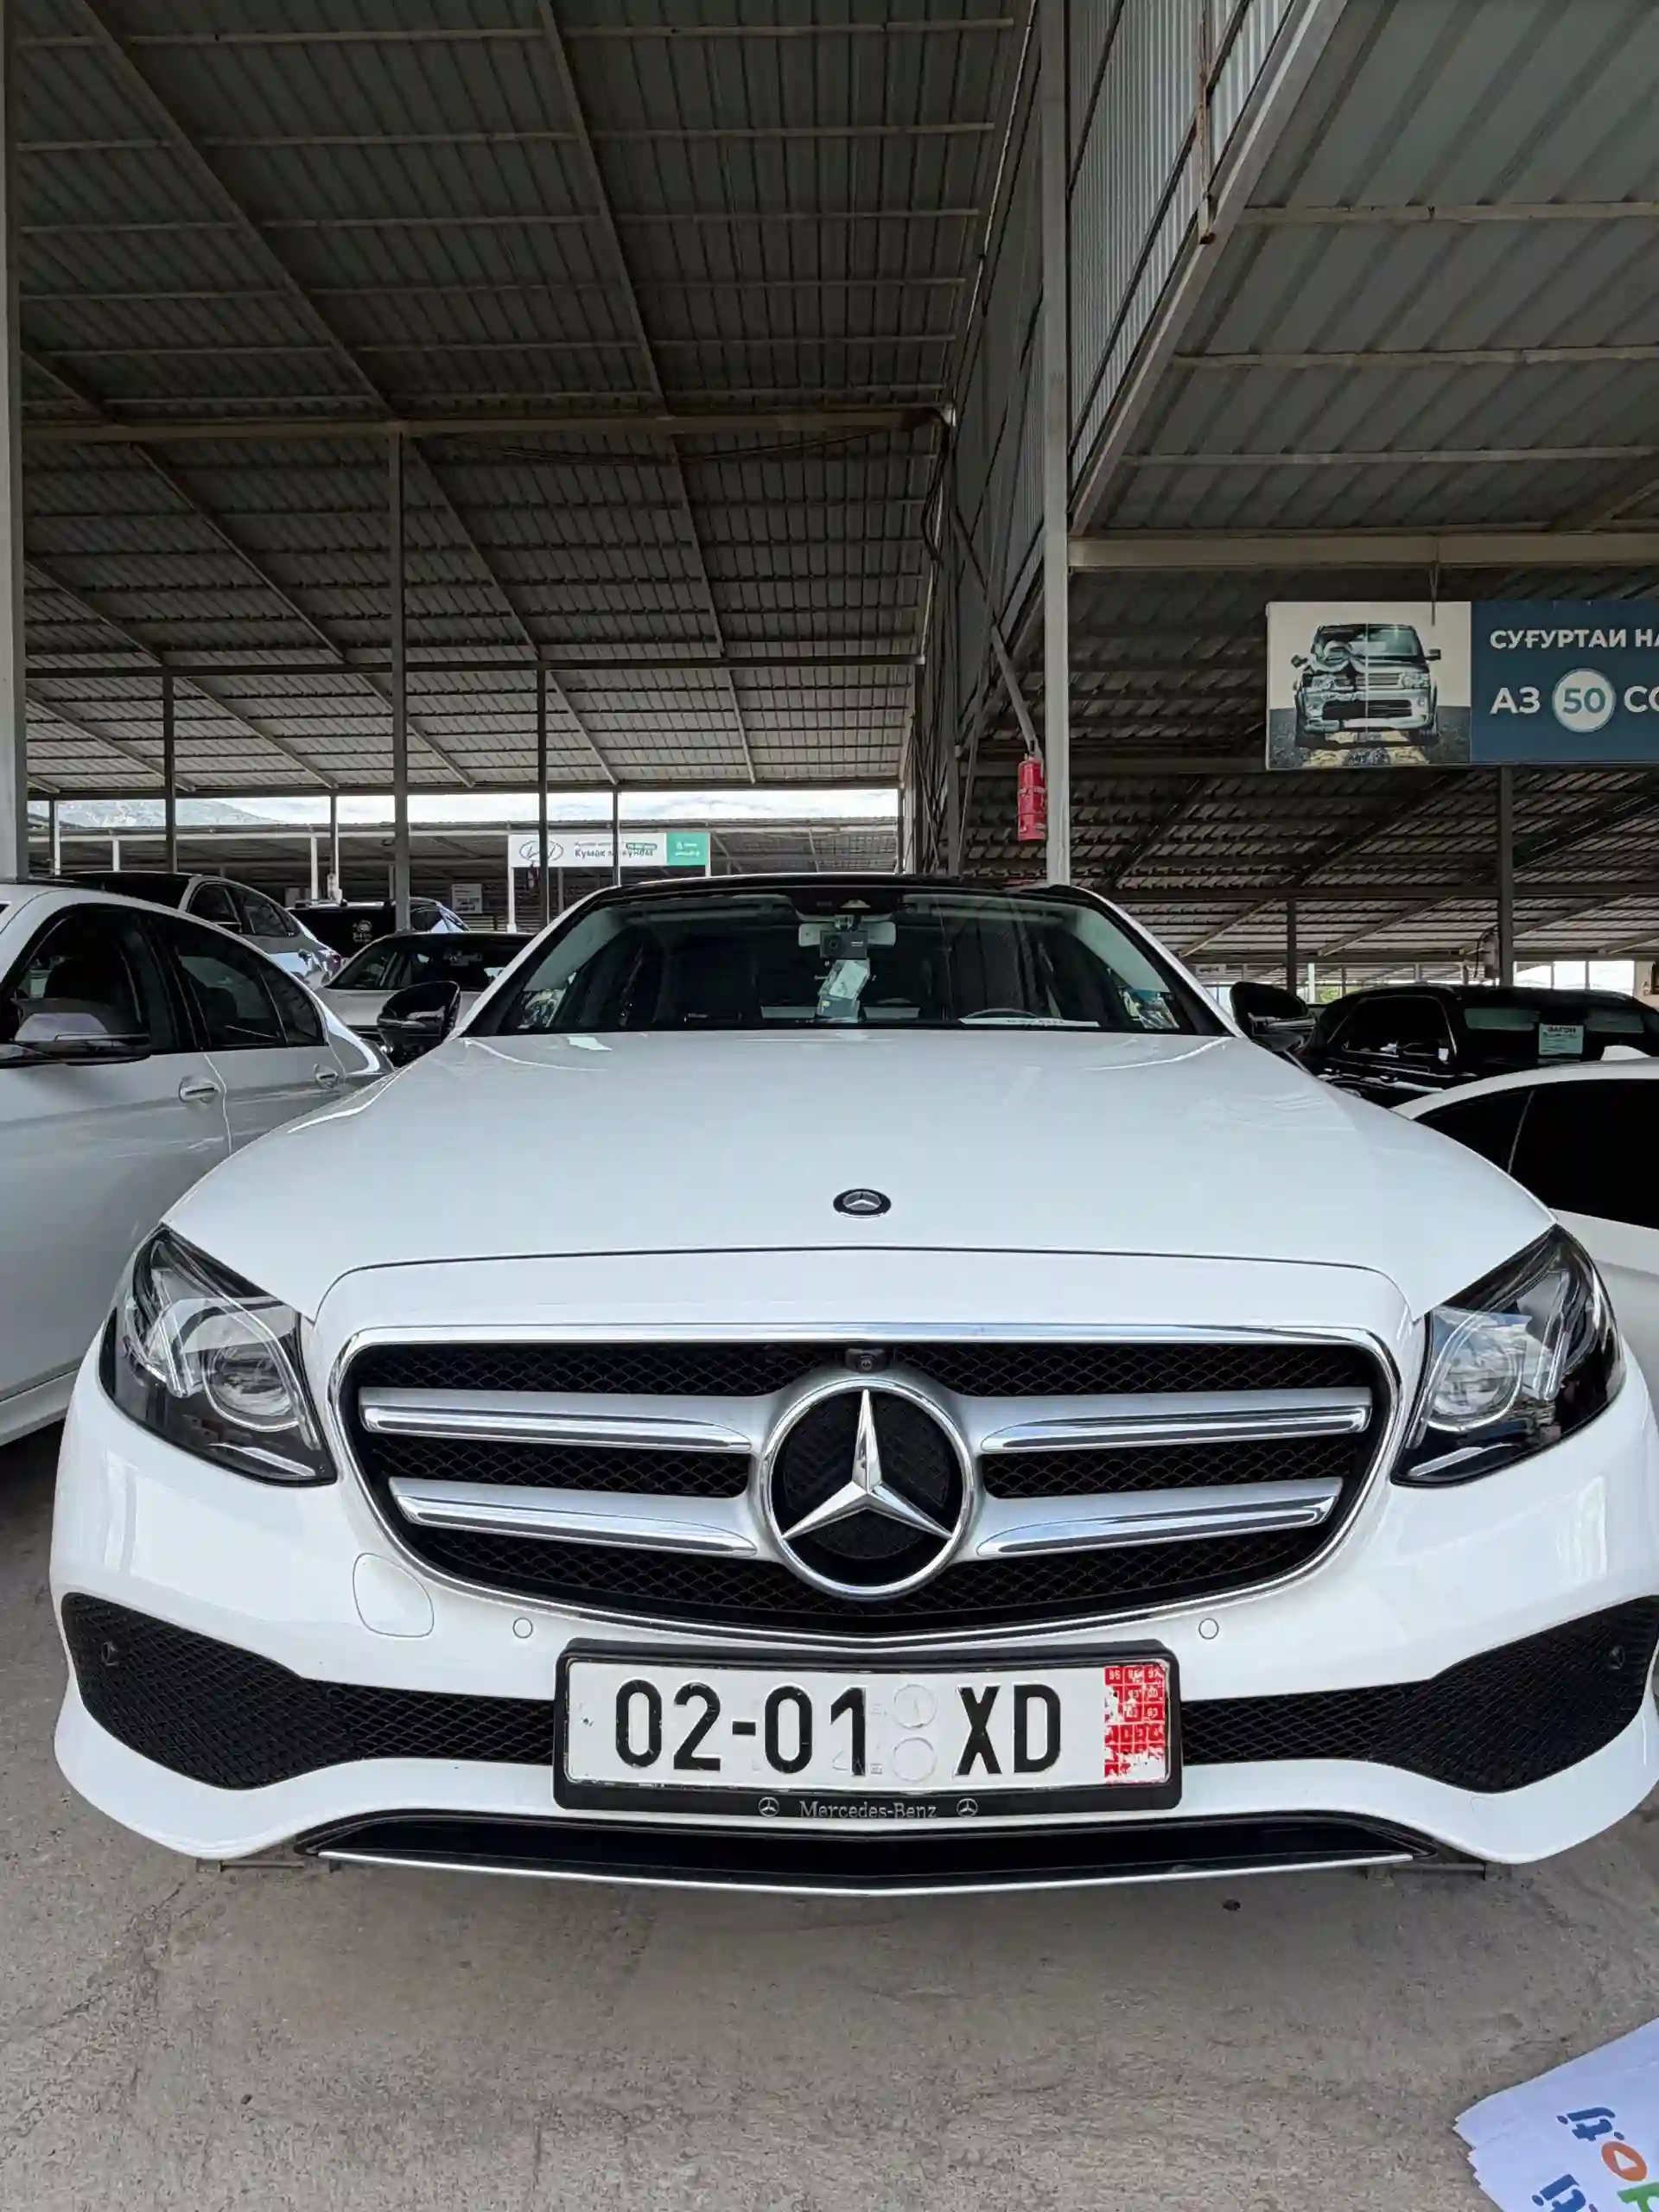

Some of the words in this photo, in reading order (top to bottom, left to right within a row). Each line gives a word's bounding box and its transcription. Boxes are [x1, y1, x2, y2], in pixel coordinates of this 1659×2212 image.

[1491, 687, 1541, 715] АЗ
[1562, 688, 1606, 714] 50
[615, 1678, 867, 1777] 02-01
[955, 1684, 1061, 1777] XD
[799, 1800, 938, 1820] Mercedes-Benz
